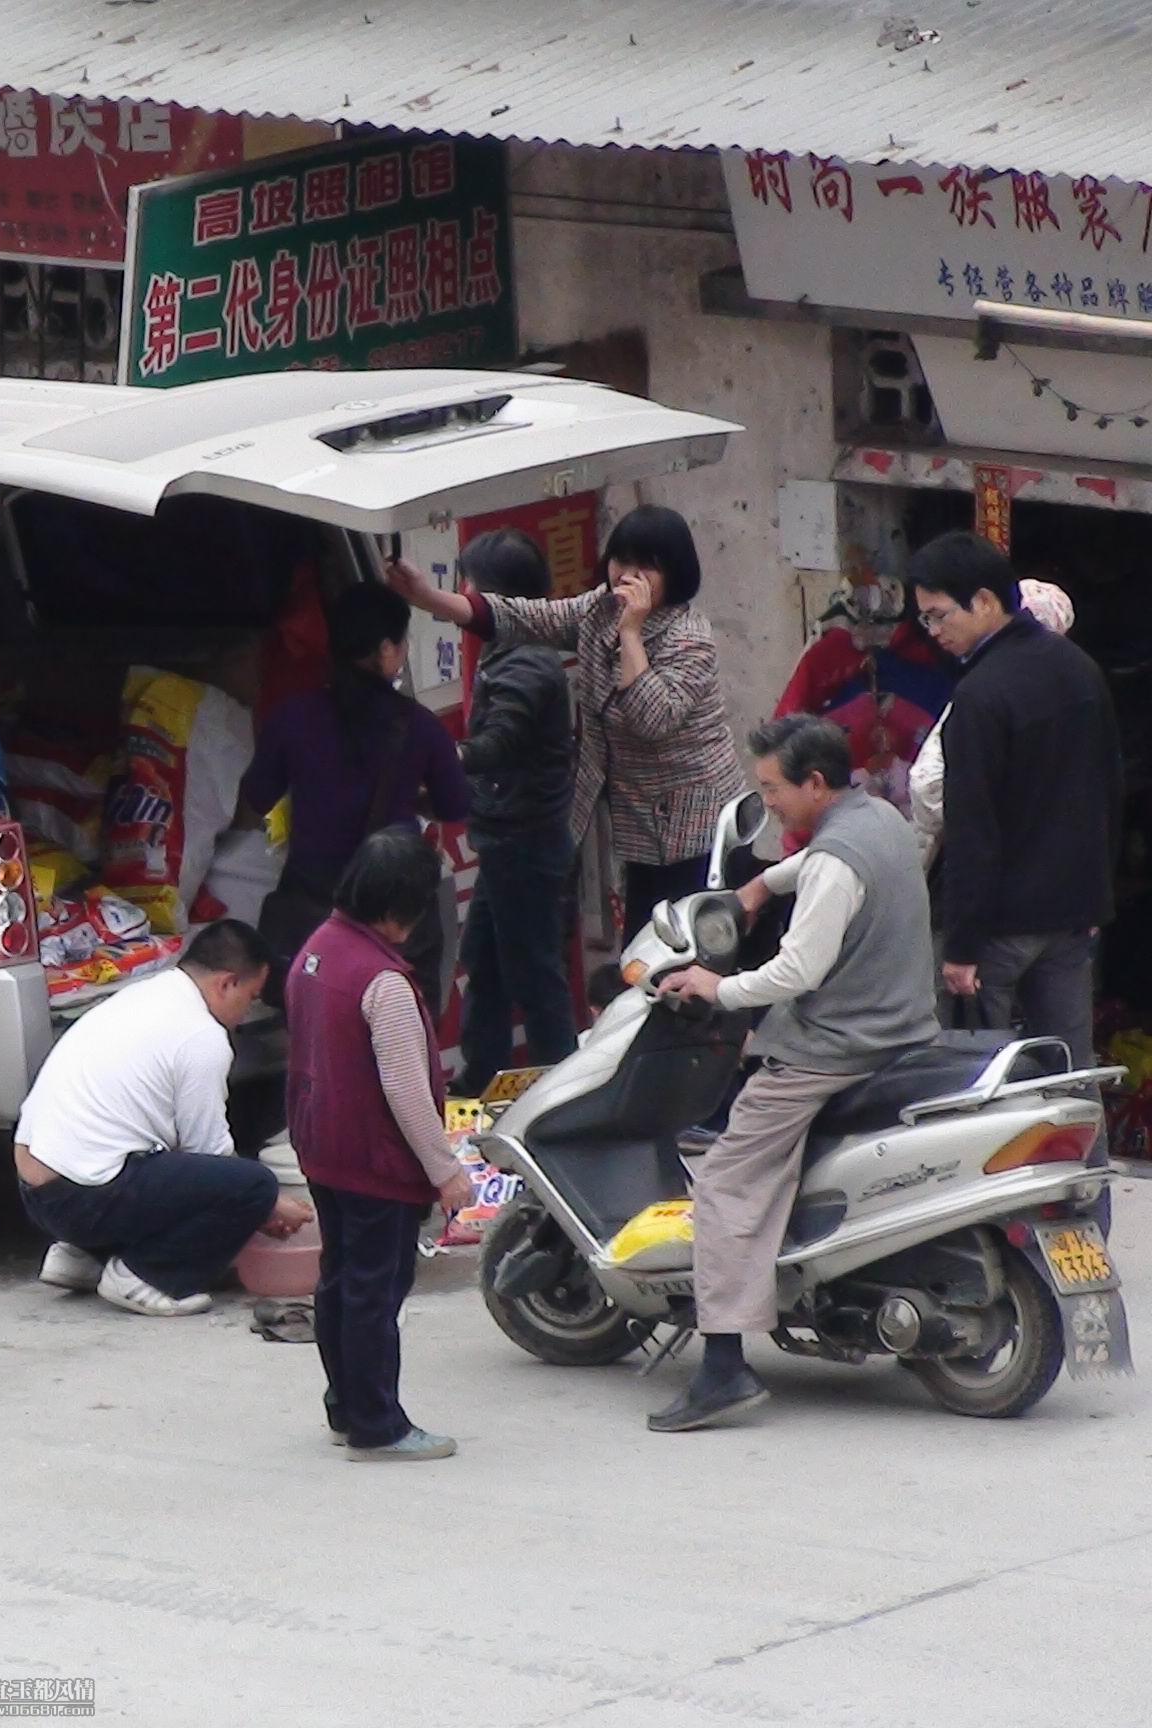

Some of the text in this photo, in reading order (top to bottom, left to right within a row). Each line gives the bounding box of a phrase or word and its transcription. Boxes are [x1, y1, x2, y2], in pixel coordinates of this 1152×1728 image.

[193, 141, 457, 247] 高坡照相馆
[745, 148, 1152, 253] 时尚一族服装
[138, 206, 503, 378] 第二代身份证照相点
